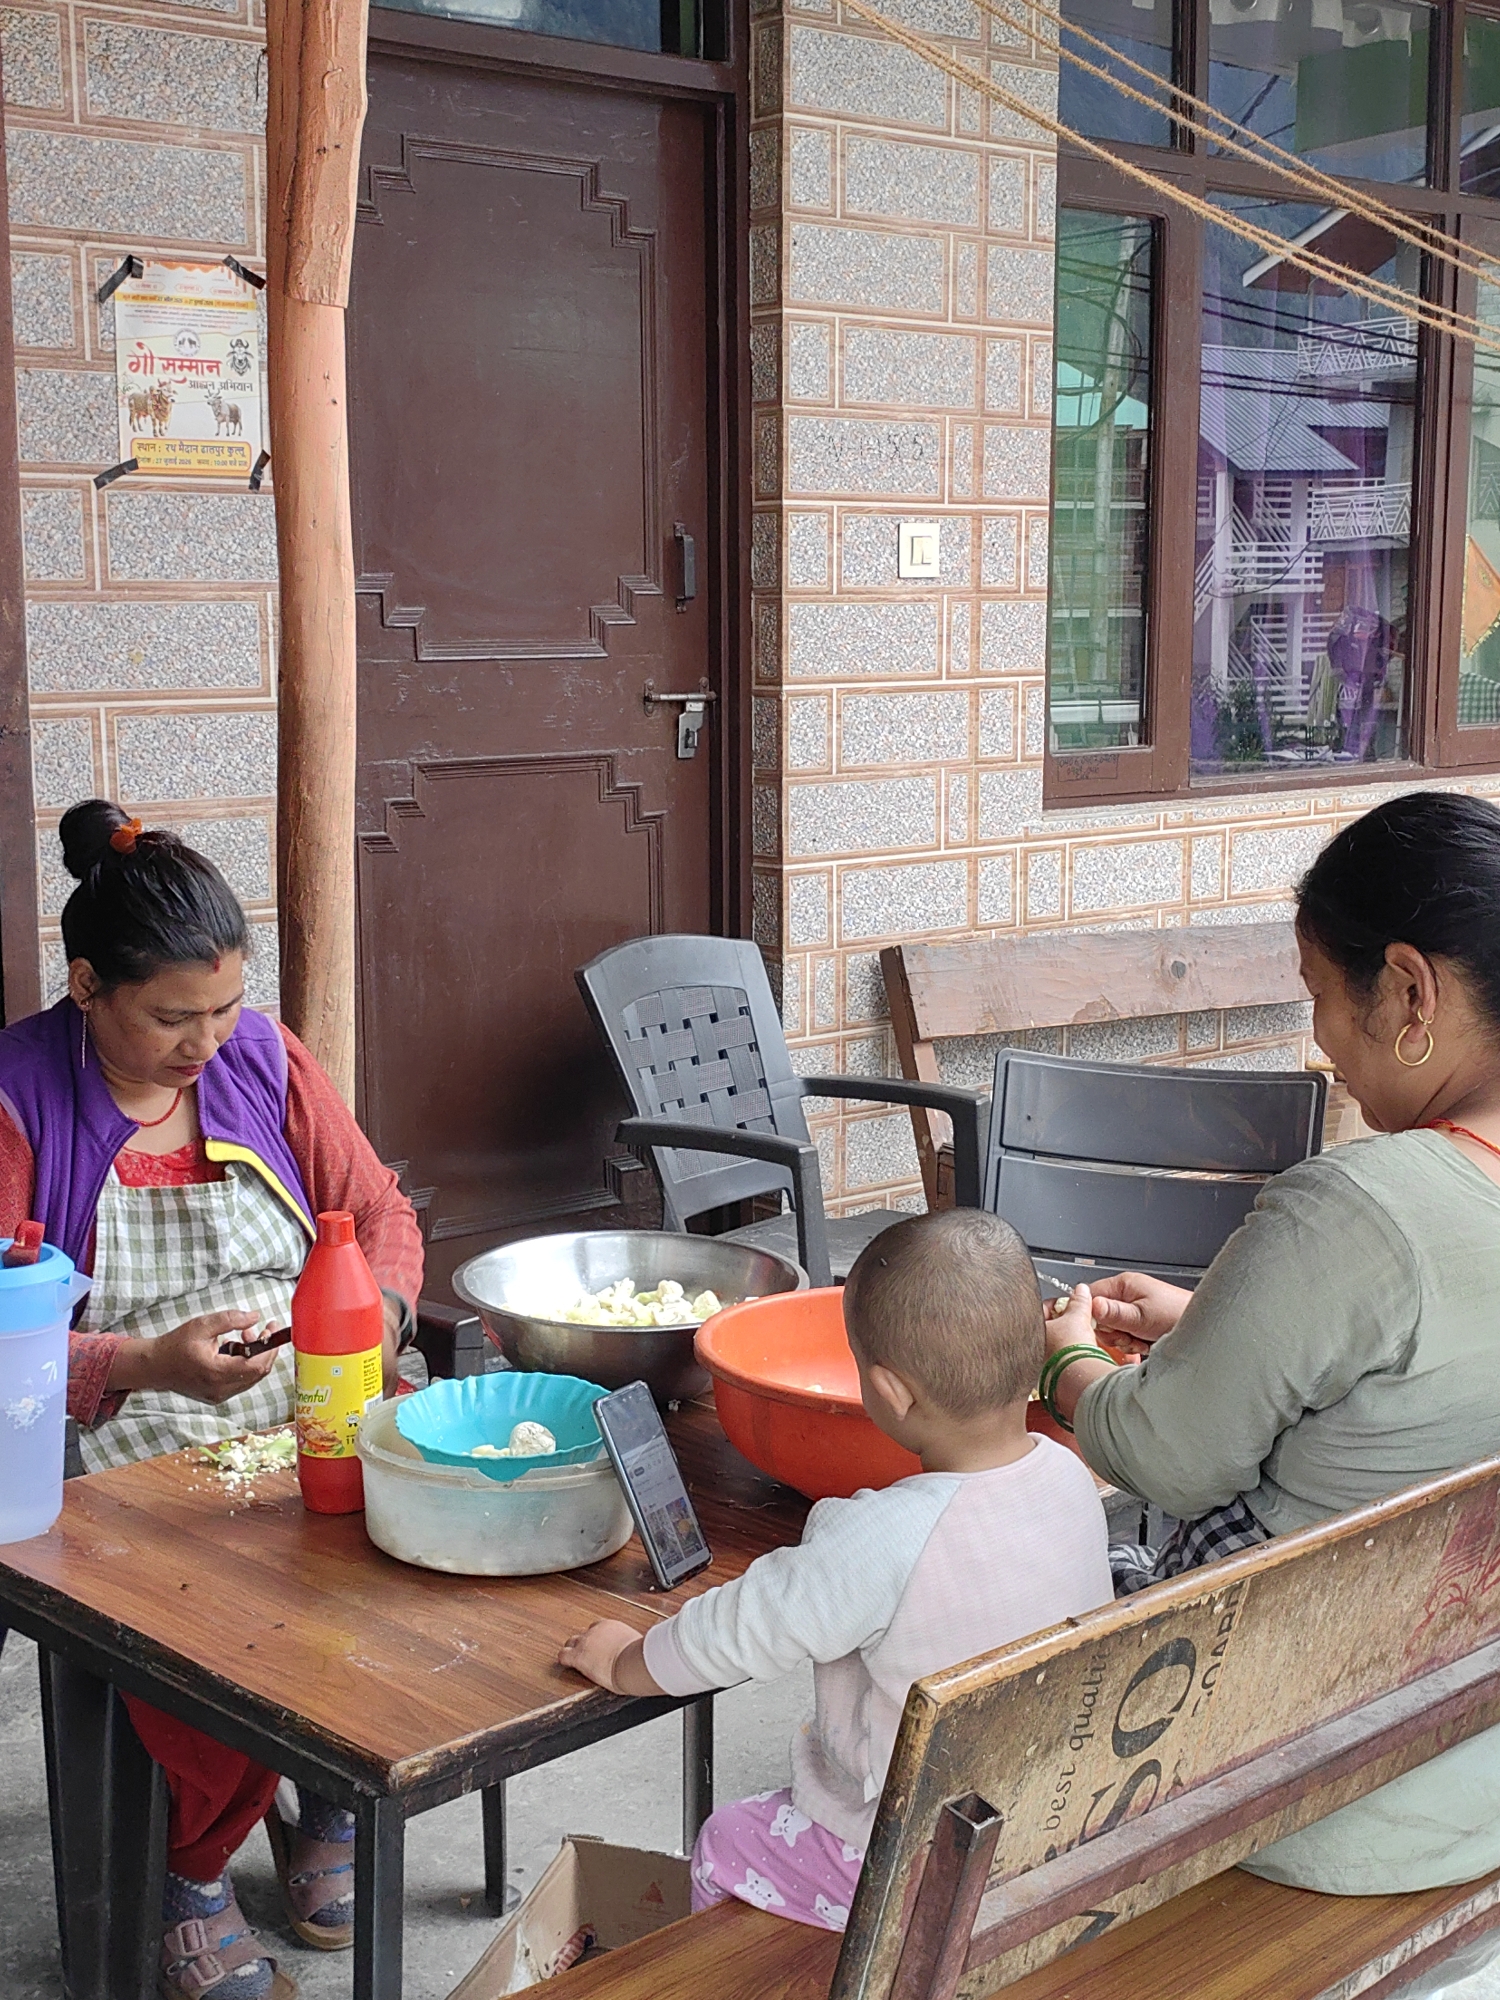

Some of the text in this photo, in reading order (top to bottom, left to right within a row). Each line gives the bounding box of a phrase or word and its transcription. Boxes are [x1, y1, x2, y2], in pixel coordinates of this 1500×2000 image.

[157, 356, 224, 378] सम्मान
[219, 379, 254, 392] अभियान
[165, 442, 177, 453] रथ
[178, 440, 199, 454] मैदान
[227, 446, 246, 458] कुल्लू
